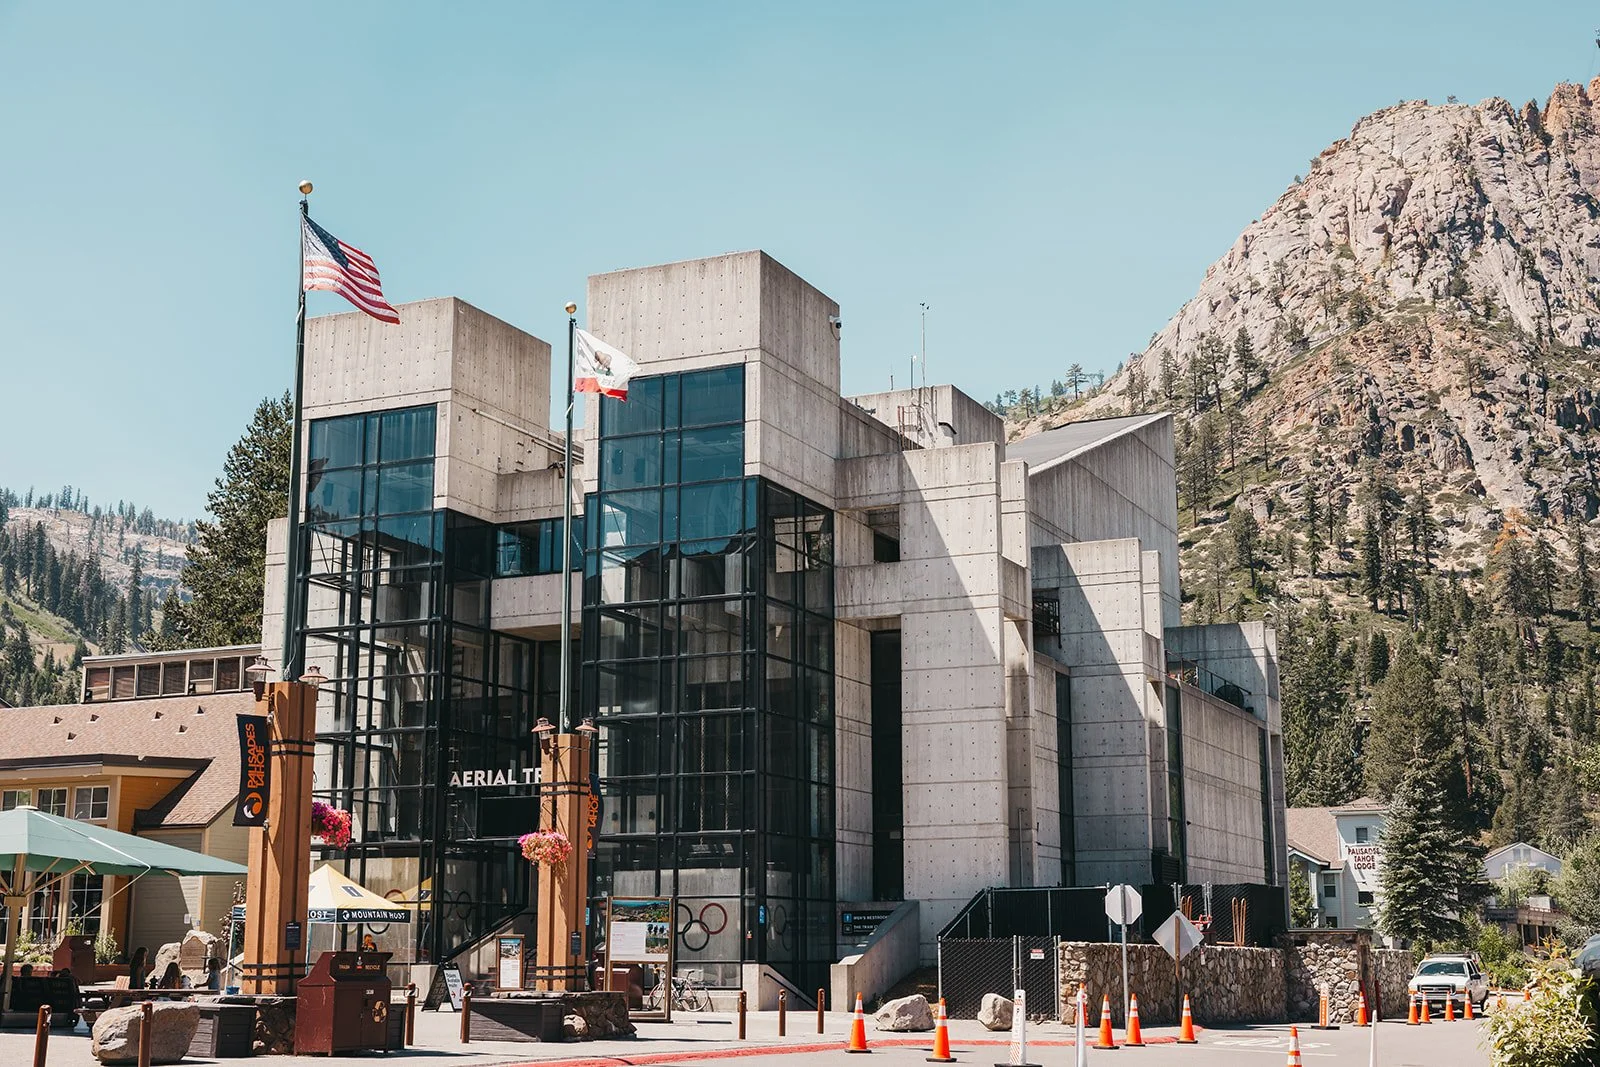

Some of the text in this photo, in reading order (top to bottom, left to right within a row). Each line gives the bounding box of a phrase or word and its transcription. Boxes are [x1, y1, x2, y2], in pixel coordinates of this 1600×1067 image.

[245, 723, 257, 789] PALISADES
[256, 745, 265, 787] TAHOE
[449, 769, 517, 787] AERIAL
[1354, 862, 1376, 870] LODGE
[308, 910, 328, 919] OST
[351, 910, 406, 919] MOUNTAIN HOST
